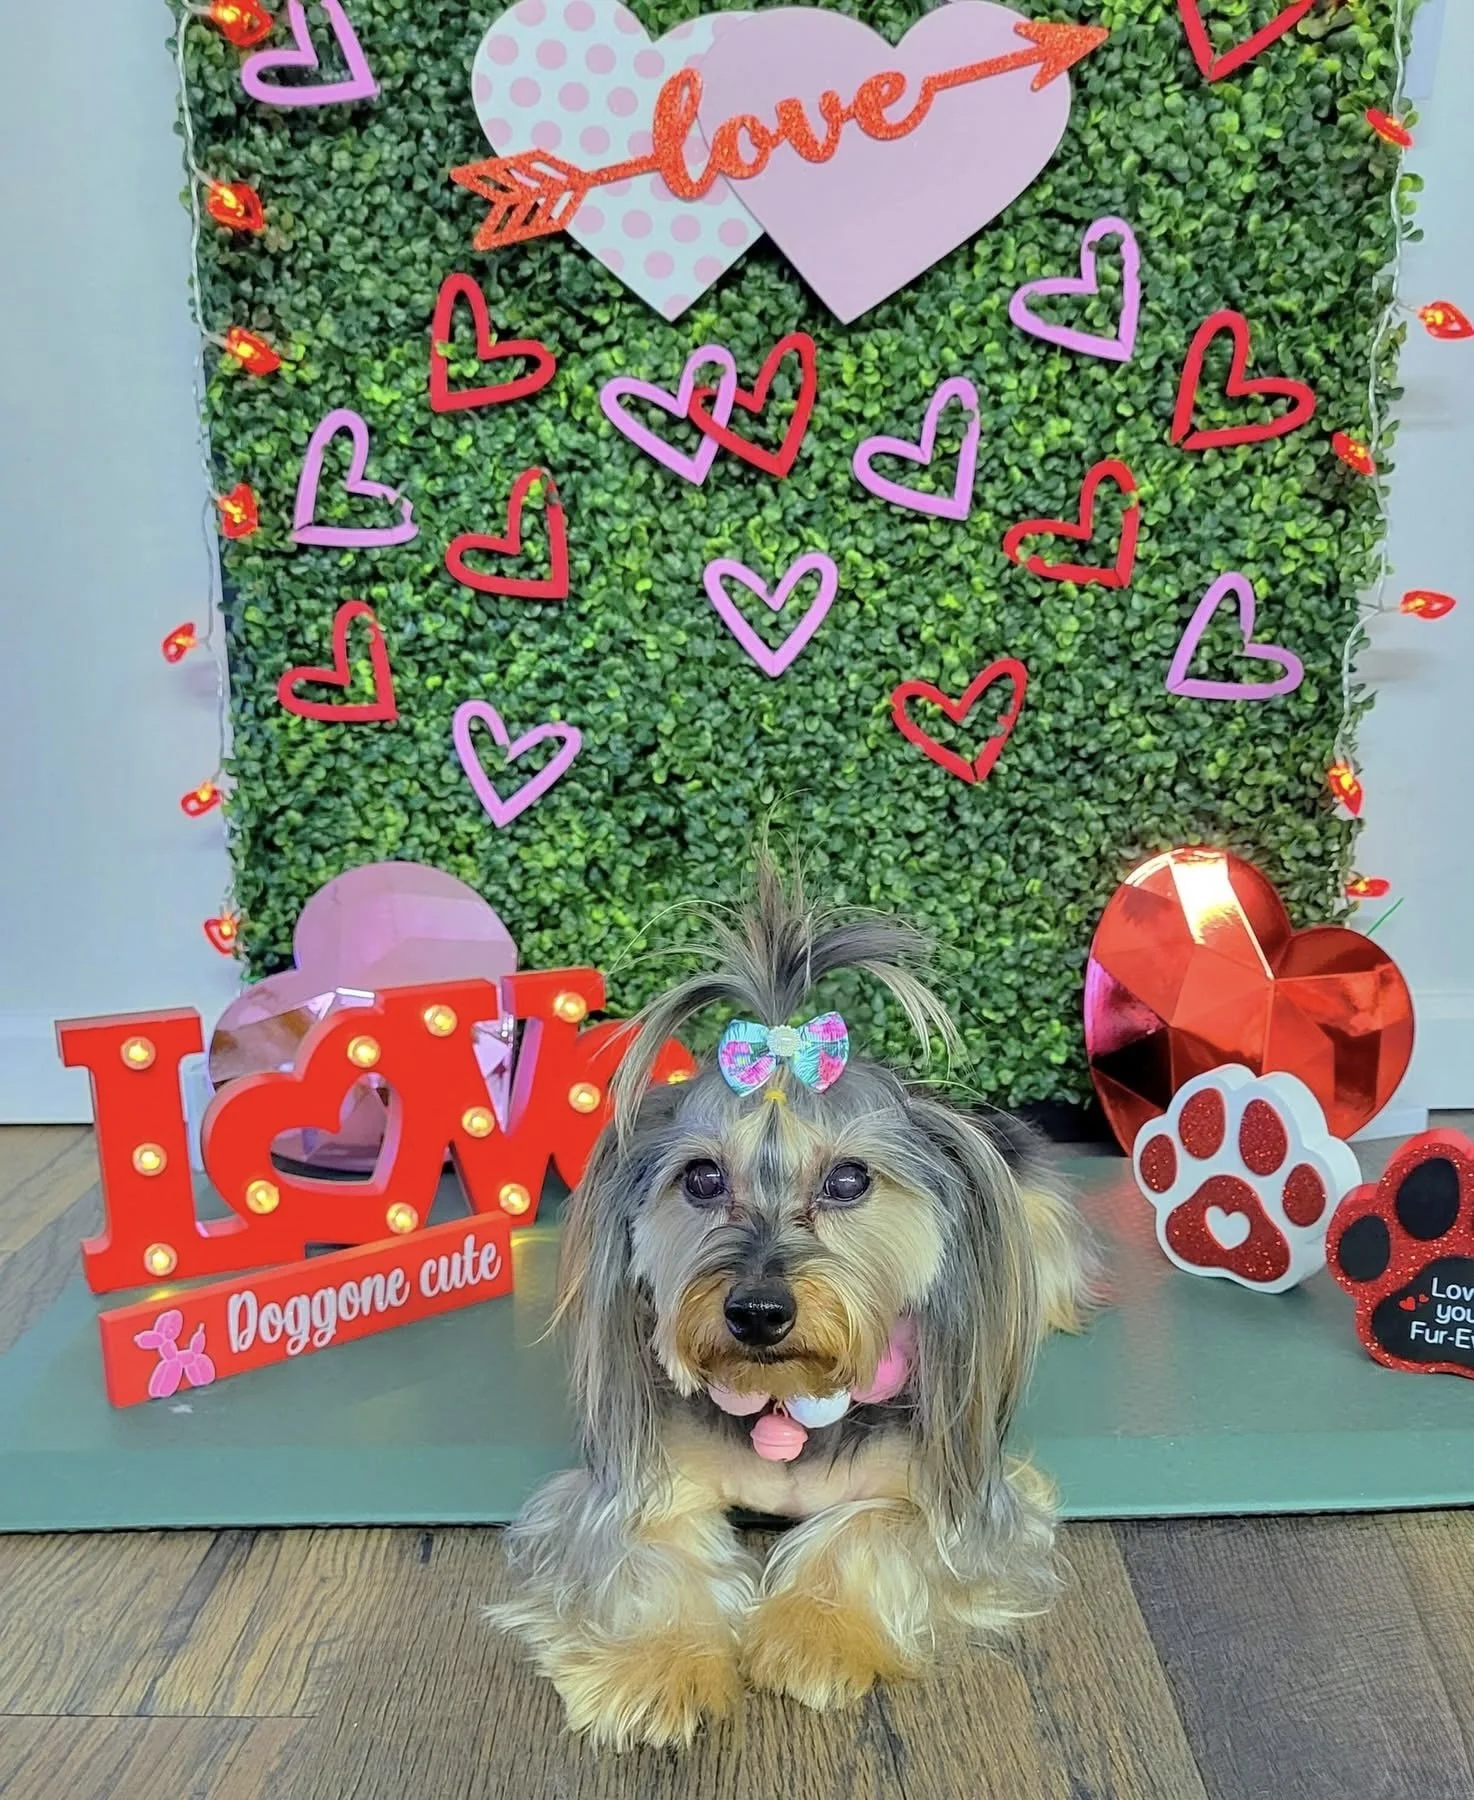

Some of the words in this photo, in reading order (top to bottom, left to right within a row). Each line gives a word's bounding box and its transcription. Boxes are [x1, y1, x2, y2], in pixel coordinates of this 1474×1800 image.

[651, 66, 932, 201] love
[226, 1267, 411, 1356] Doggone
[419, 1233, 502, 1297] cute
